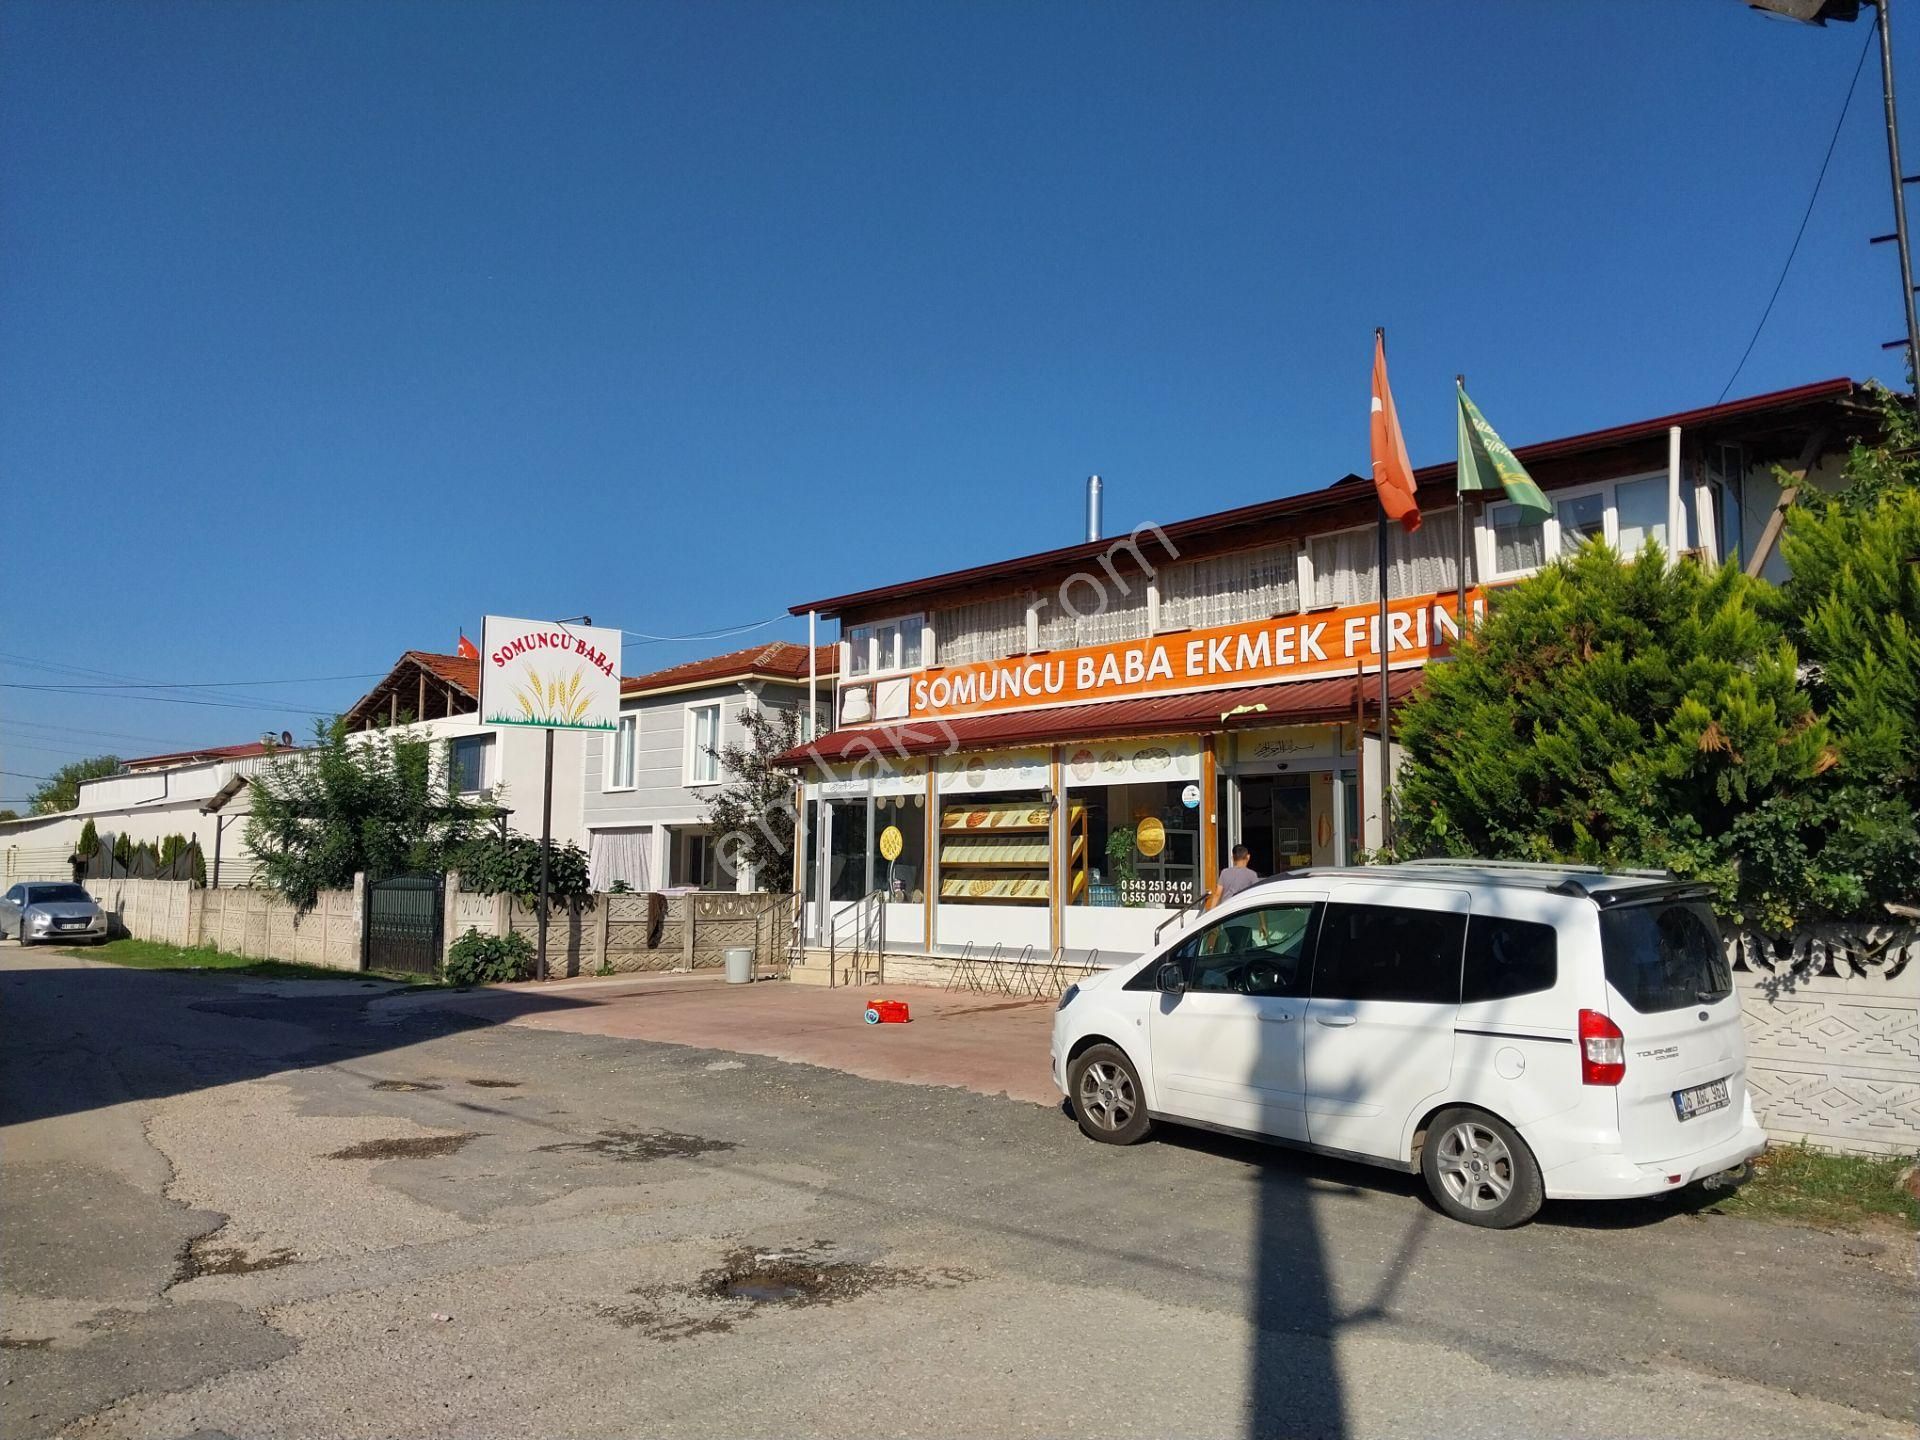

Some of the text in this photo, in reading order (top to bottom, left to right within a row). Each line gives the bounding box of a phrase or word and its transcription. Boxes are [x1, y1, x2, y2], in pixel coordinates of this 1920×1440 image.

[491, 632, 615, 677] SOMUNCU BABA
[914, 660, 1065, 711] SOMUNCU
[1076, 645, 1174, 690] BABA
[1186, 622, 1328, 677] EKMEK
[1129, 880, 1146, 890] 543
[1148, 880, 1164, 891] 251
[1165, 881, 1178, 891] 34
[1129, 891, 1146, 903] 555
[1148, 892, 1166, 903] 000
[1168, 892, 1180, 903] 76
[1182, 893, 1193, 904] 12
[1637, 1046, 1679, 1058] TOURNEO
